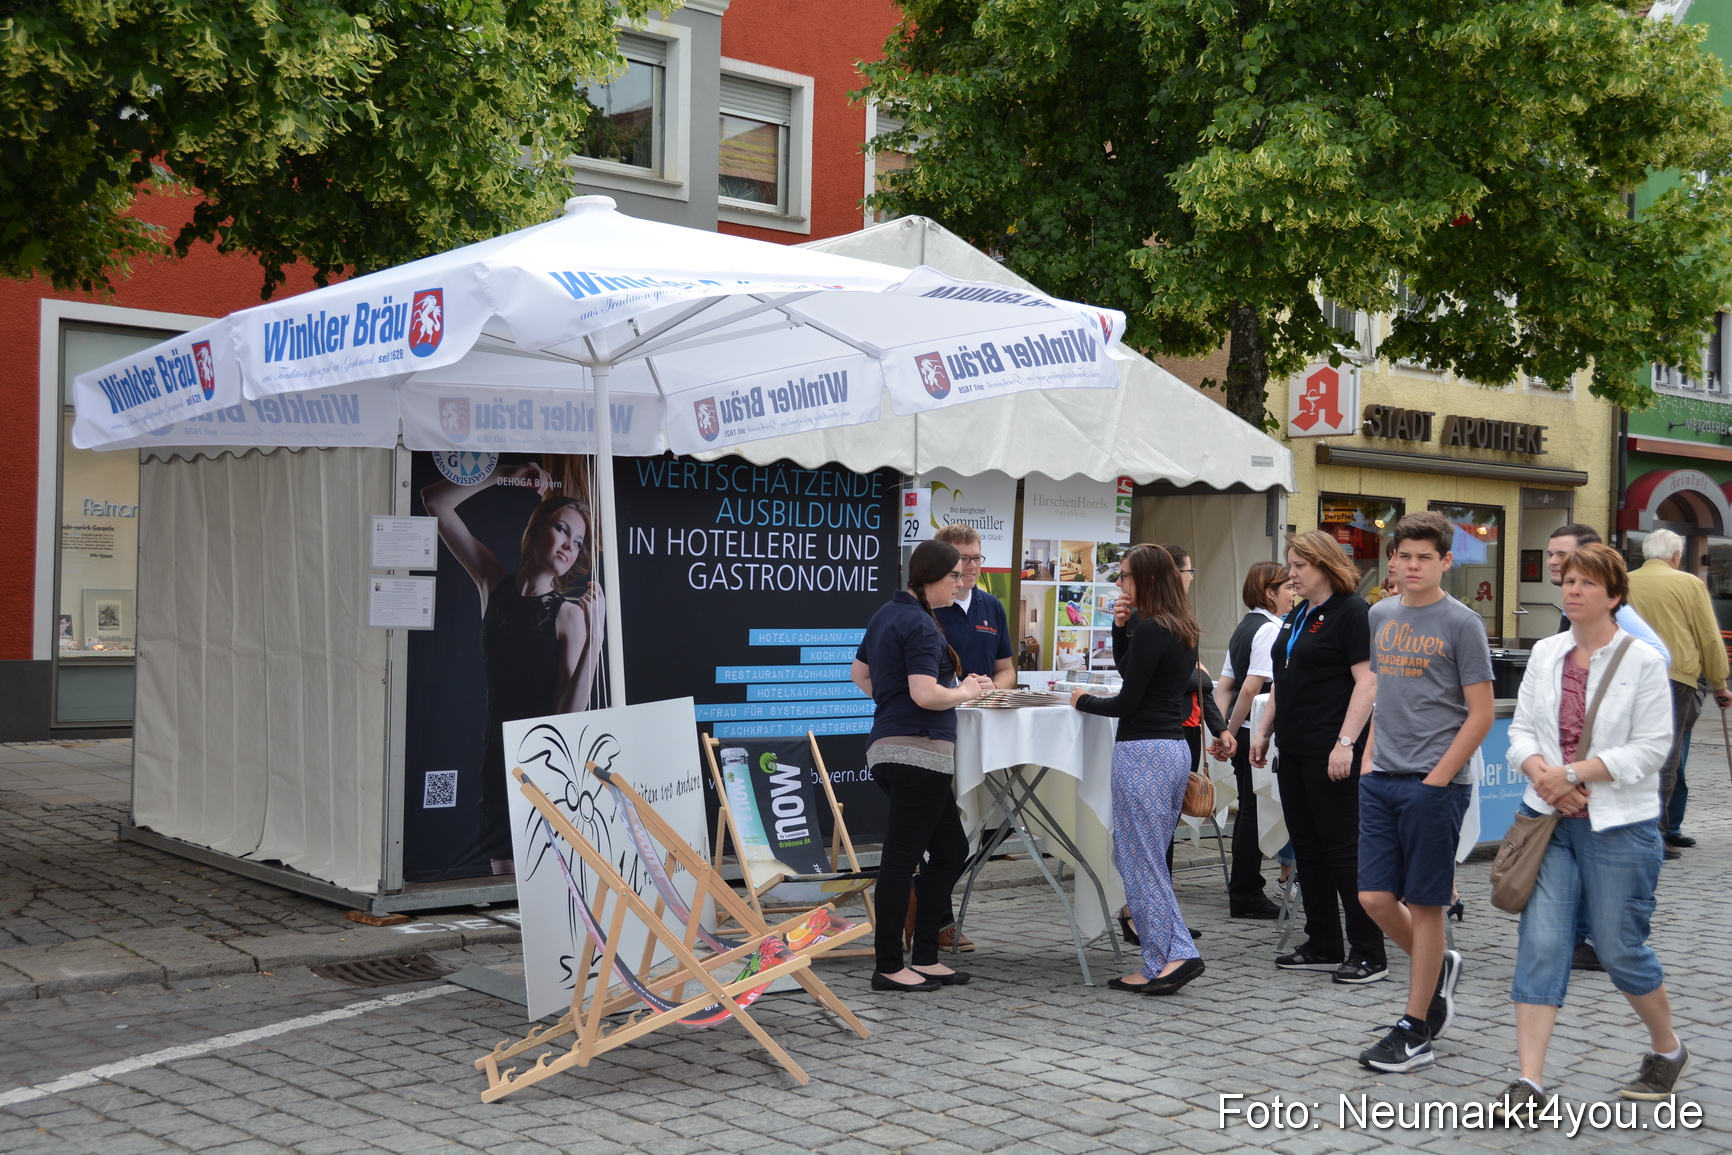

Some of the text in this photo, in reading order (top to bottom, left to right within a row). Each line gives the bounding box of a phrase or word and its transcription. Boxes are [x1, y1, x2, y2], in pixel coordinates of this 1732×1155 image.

[264, 295, 408, 364] Winkler Bräu
[390, 349, 404, 361] 1628
[98, 365, 161, 415] Winkler
[155, 348, 198, 394] Bräu
[1365, 404, 1548, 454] STADT APOTHEKE
[497, 476, 562, 489] DEHOGA Bayern
[636, 459, 883, 499] WERTSCHÄTZENDE
[715, 497, 881, 530] AUSBILDUNG
[1033, 494, 1108, 510] HirschenHotels
[629, 526, 880, 561] IN HOTELLERIE UND
[904, 519, 920, 538] 29
[688, 562, 879, 592] GASTRONOMIE
[744, 704, 763, 716] FÜR
[770, 703, 877, 716] SYSTEMGASTRONOMIE
[723, 724, 783, 736] FACHKRAFT
[790, 724, 803, 734] IM
